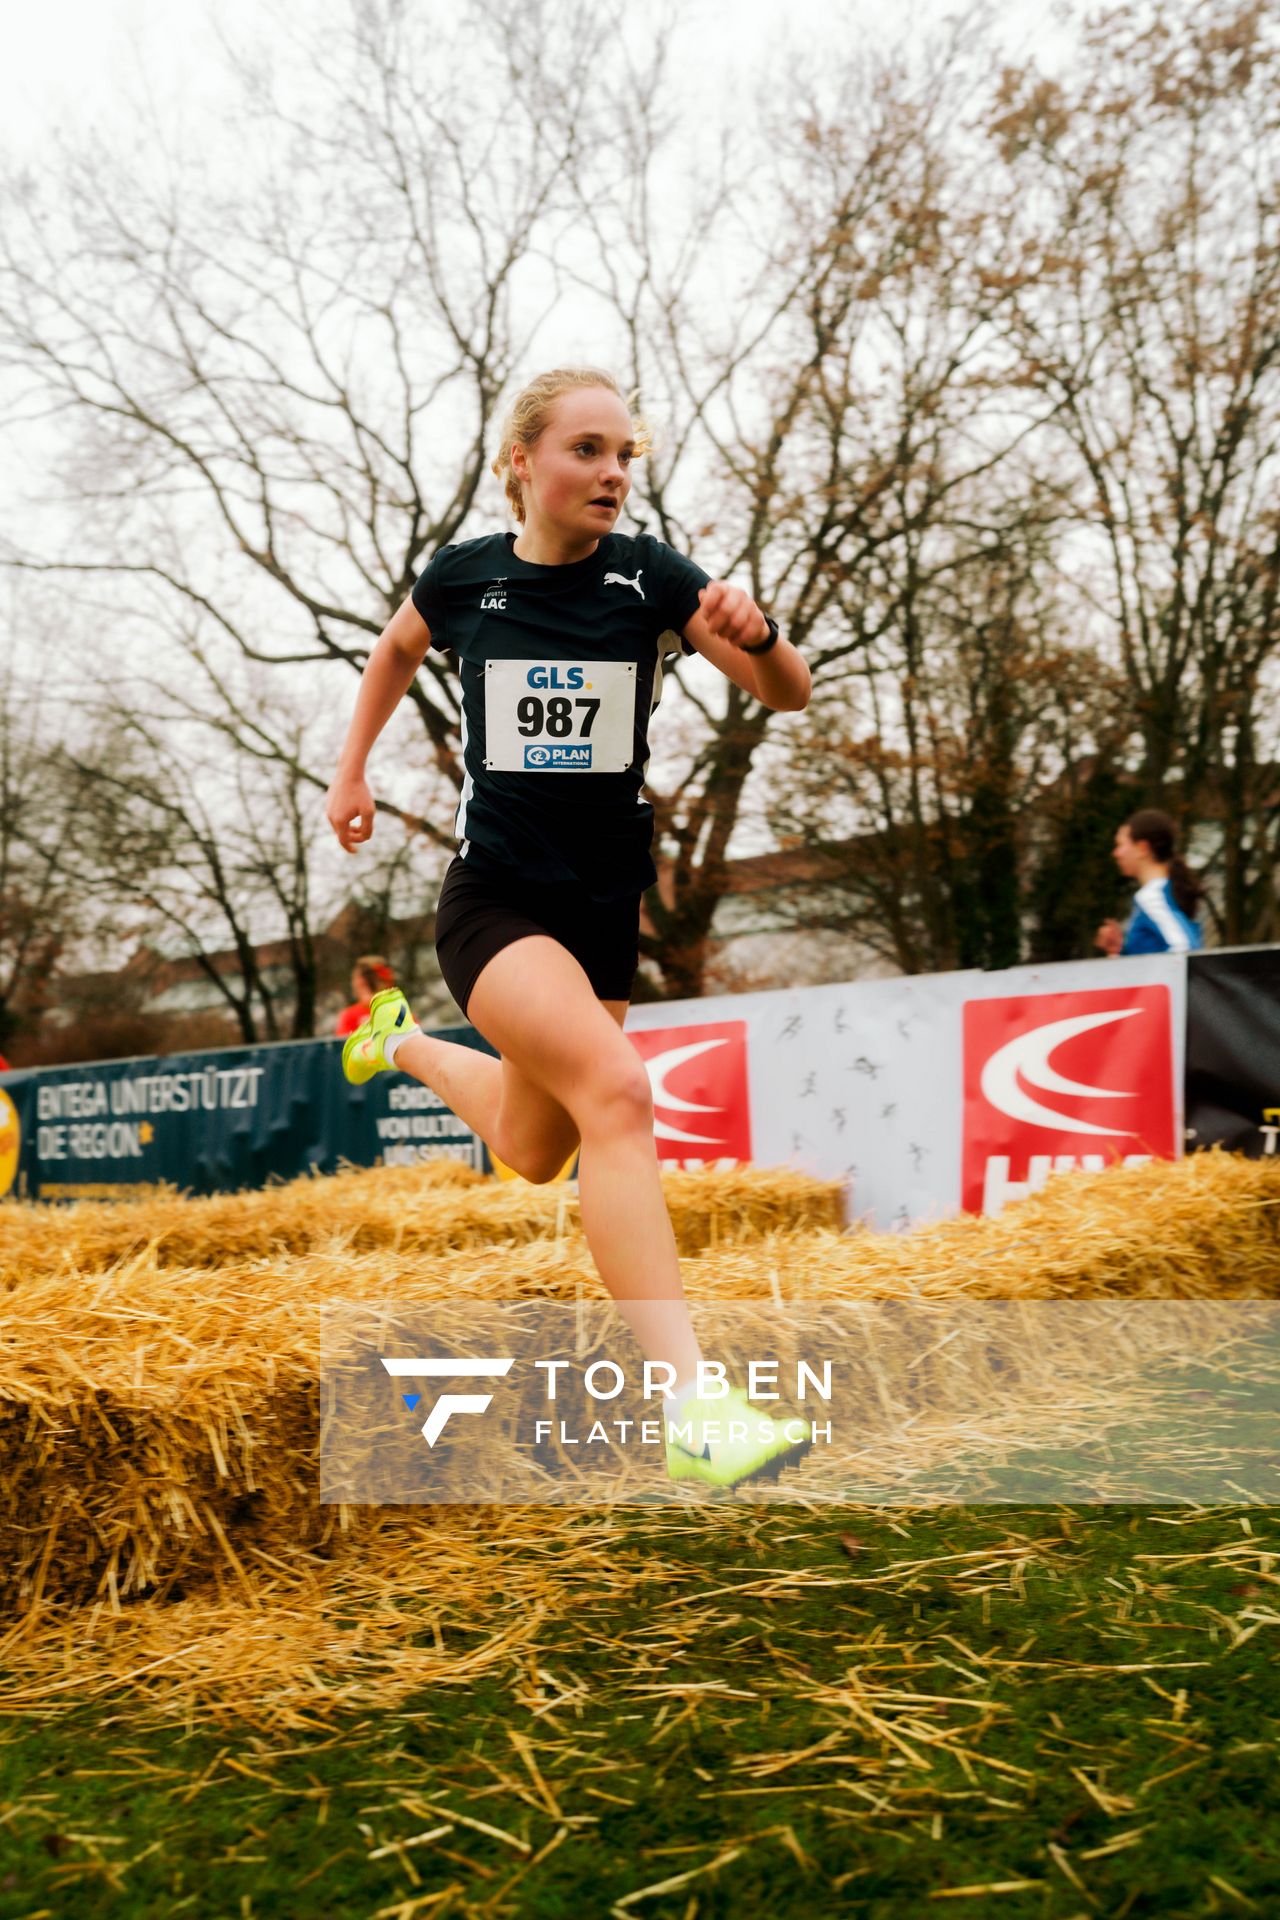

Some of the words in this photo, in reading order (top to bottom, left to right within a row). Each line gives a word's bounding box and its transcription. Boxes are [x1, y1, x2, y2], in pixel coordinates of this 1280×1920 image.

[480, 598, 507, 610] LAC
[517, 696, 600, 738] 987
[552, 749, 590, 760] PLAN
[37, 1081, 108, 1120] ENTEGA
[110, 1065, 265, 1116] UNTERSTÜTZT
